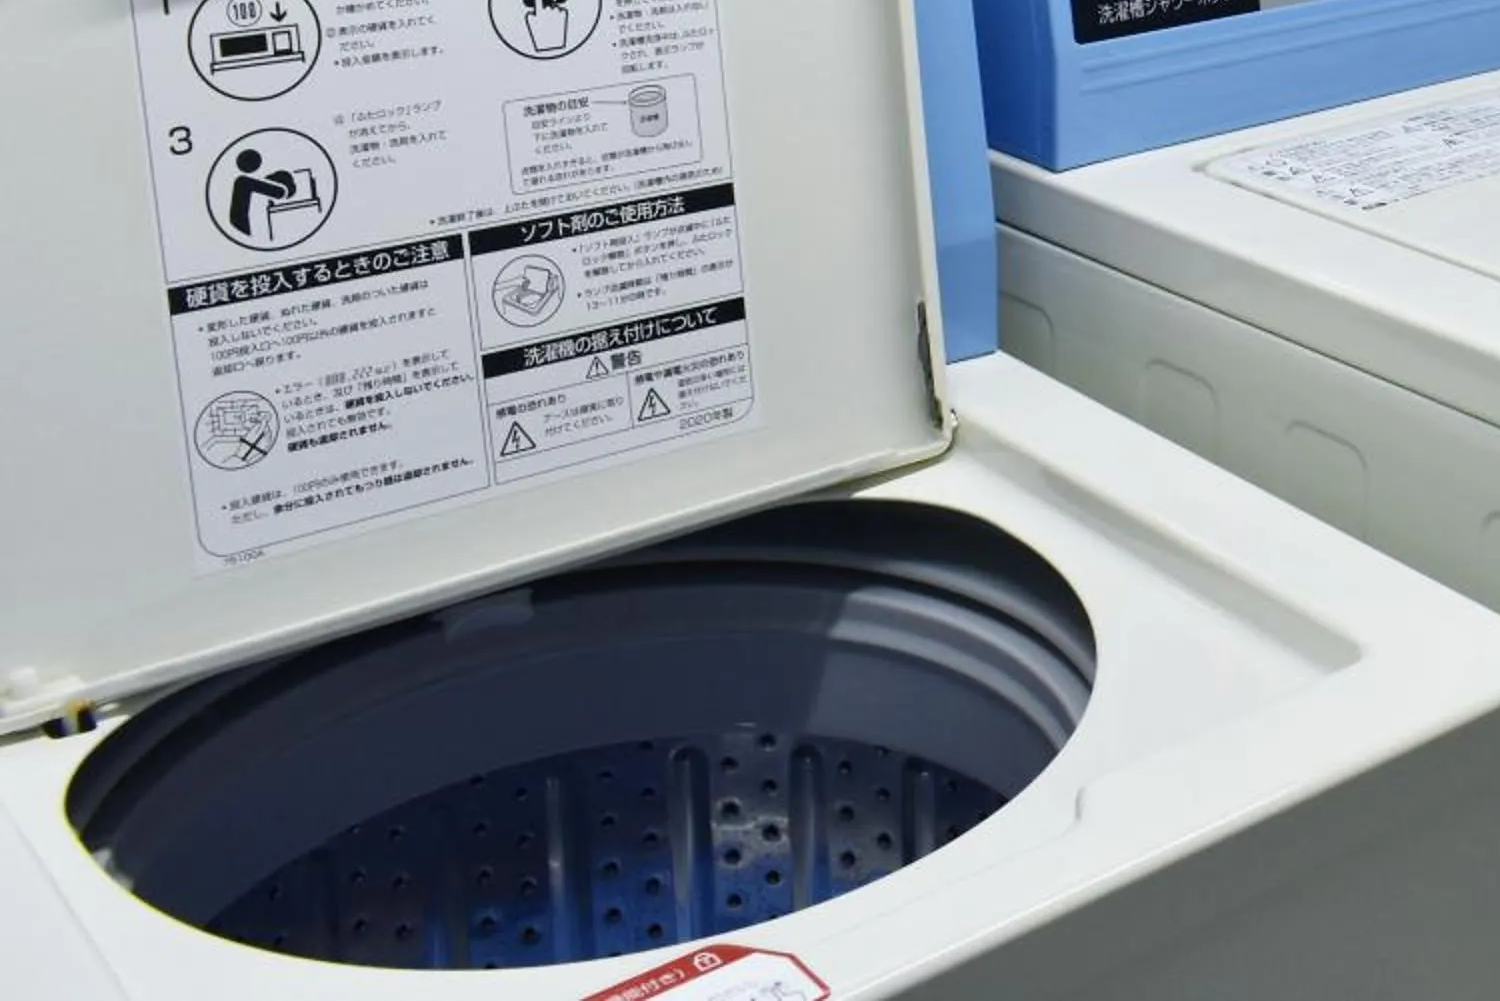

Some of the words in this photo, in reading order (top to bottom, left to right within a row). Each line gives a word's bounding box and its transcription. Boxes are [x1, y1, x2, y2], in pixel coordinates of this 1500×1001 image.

[168, 125, 193, 156] 3
[520, 197, 686, 244] ソフト剤のご使用方法
[186, 239, 449, 308] 硬貨を投入するときのご注意
[523, 306, 719, 366] 洗濯機の据え付けについて
[610, 350, 643, 371] 警告
